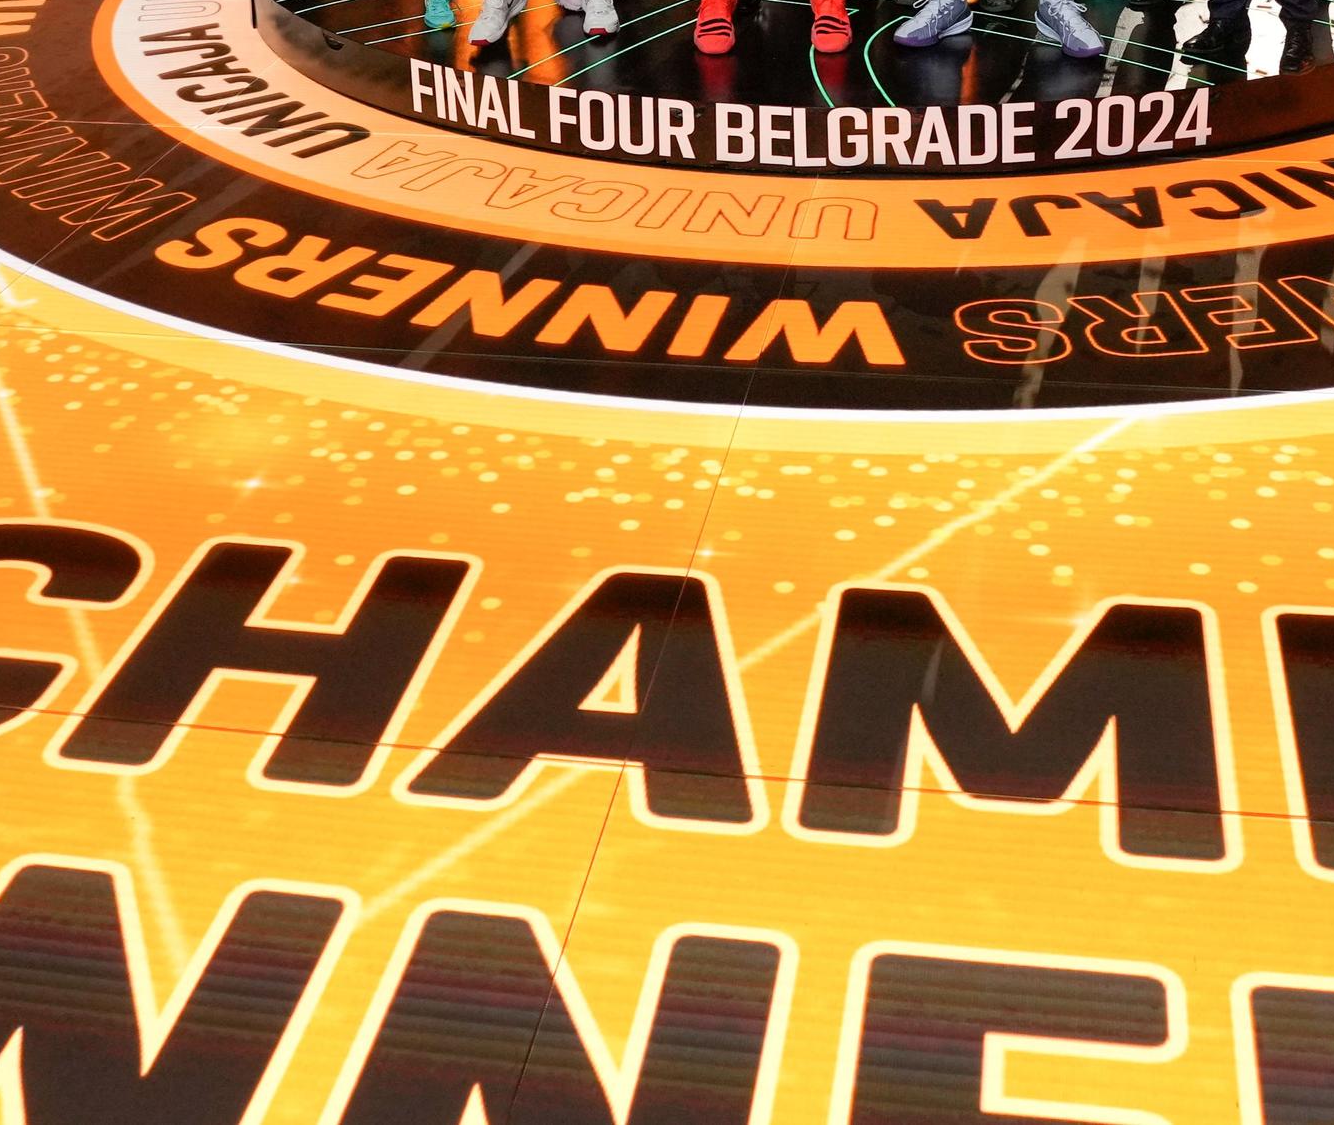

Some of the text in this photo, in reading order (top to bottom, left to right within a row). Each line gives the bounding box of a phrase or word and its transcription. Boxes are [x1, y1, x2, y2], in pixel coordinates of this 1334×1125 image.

[138, 22, 371, 159] UNICAJA
[410, 57, 1213, 168] FINAL FOUR BELGRADE 2024
[350, 139, 879, 241] UNICAJA
[153, 216, 906, 366] WINNERS
